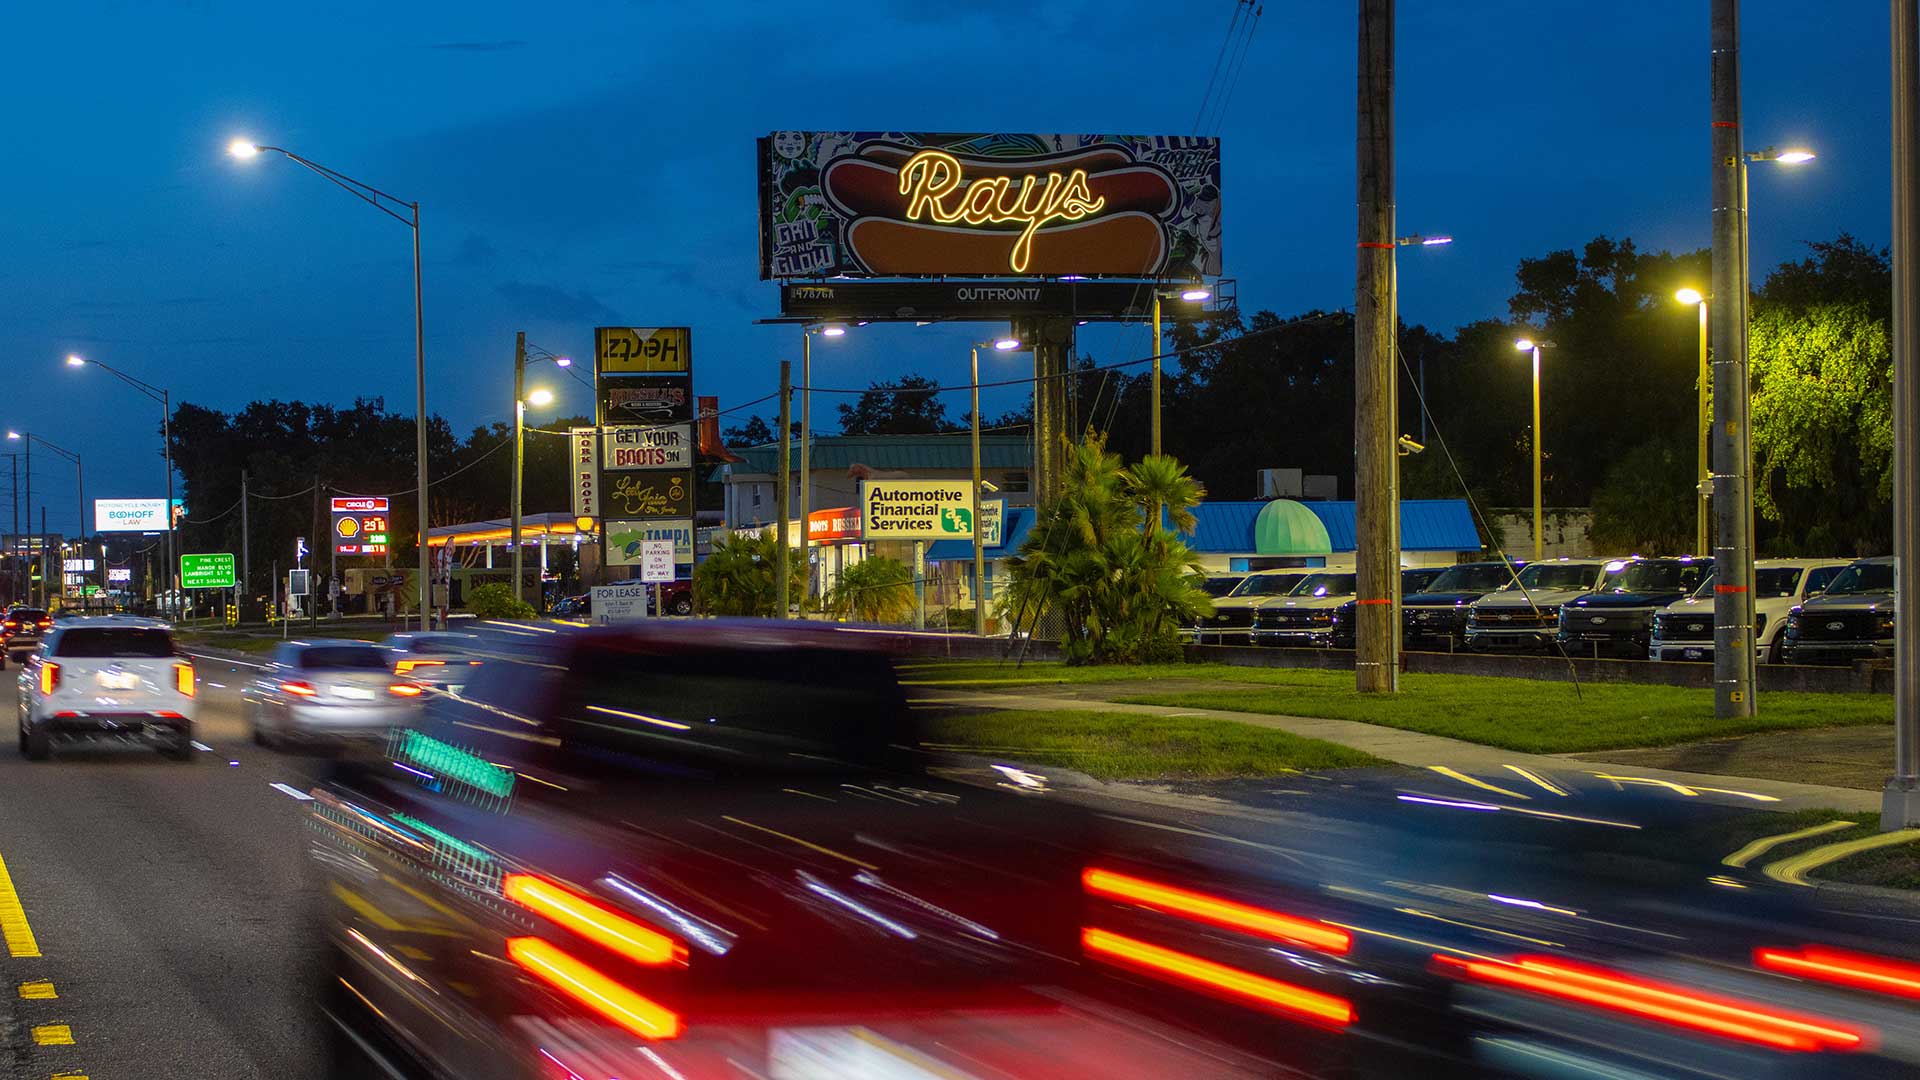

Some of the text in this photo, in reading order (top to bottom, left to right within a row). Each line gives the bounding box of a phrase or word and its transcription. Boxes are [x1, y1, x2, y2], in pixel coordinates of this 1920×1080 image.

[899, 150, 1104, 272] Rays
[775, 220, 819, 245] GRIT
[790, 241, 813, 254] AND
[774, 244, 835, 275] GLOW
[603, 337, 681, 362] Hertz
[615, 429, 679, 447] GET YOUR
[616, 448, 680, 467] BOOTS ON
[579, 432, 592, 514] WORK BOOTS
[869, 487, 962, 502] Automotive
[870, 501, 939, 516] Financial
[870, 516, 933, 531] Services
[646, 529, 690, 546] TAMPA
[597, 588, 641, 599] FOR LEASE
